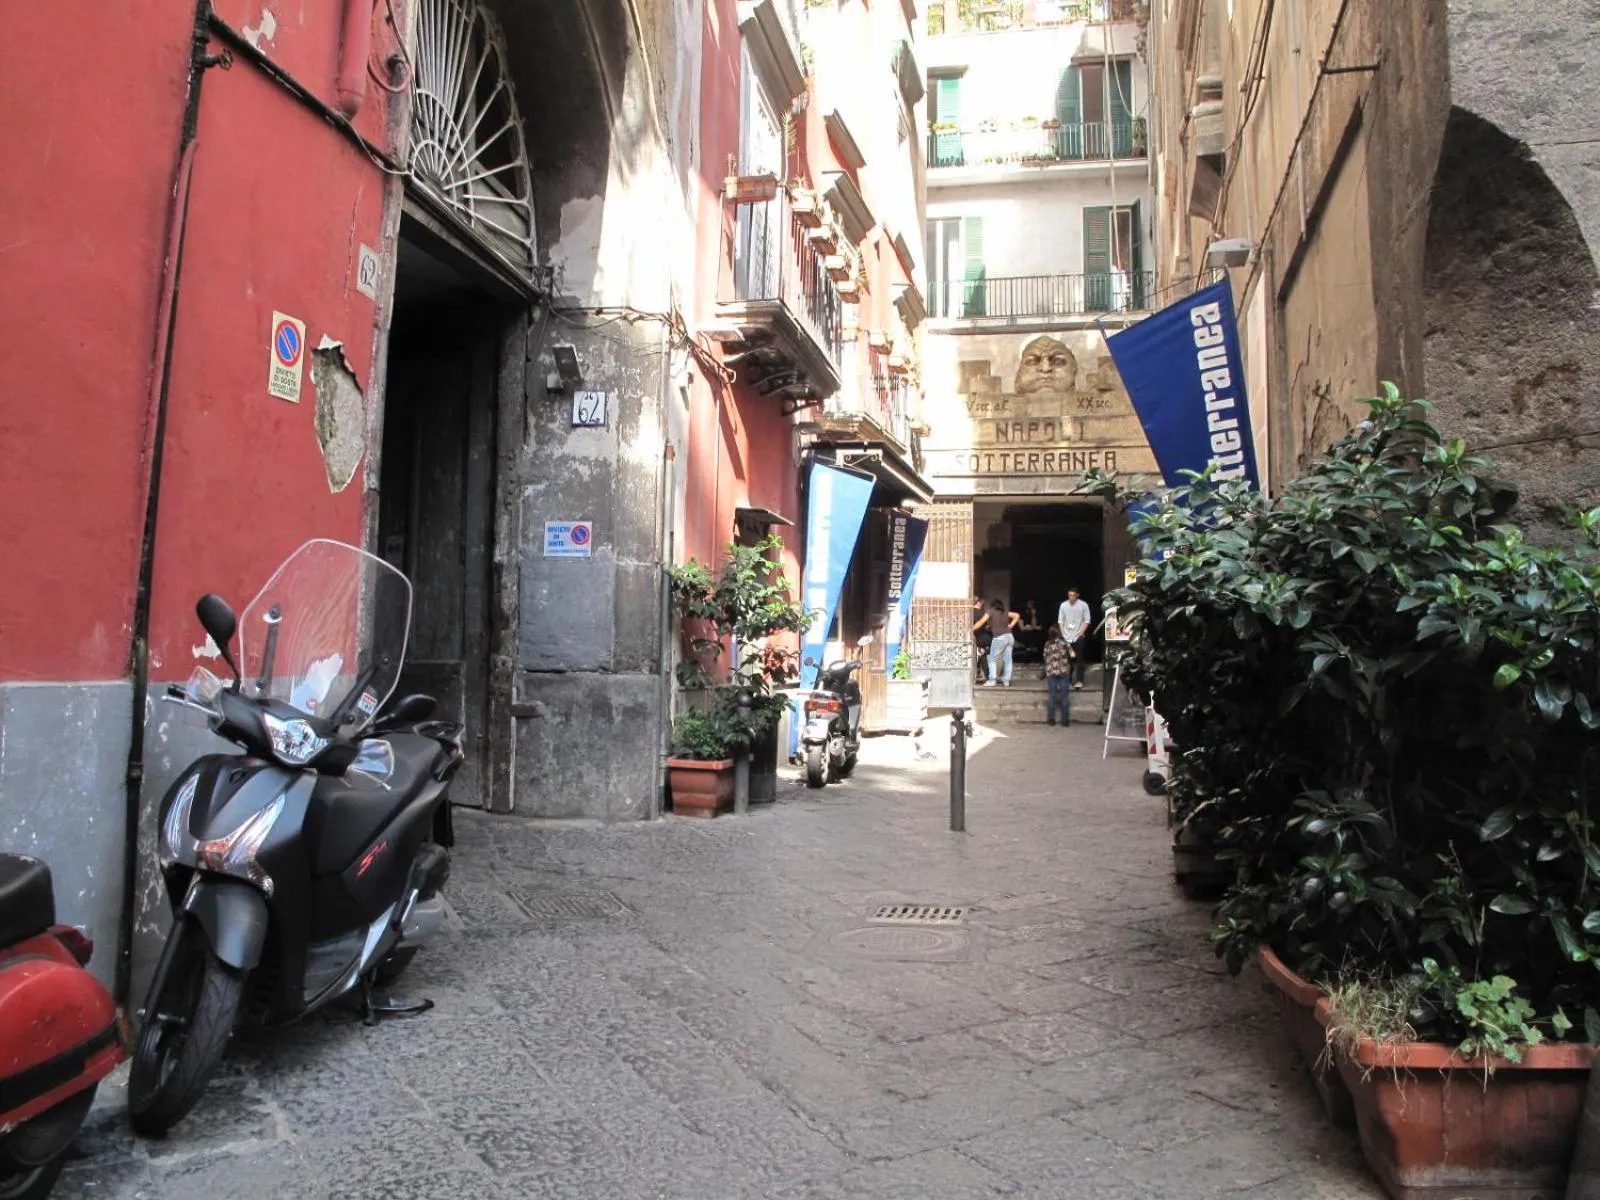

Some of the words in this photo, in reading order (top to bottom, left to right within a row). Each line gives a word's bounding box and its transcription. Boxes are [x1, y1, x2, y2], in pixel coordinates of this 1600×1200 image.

[360, 255, 376, 287] 62
[578, 391, 601, 424] 62
[1190, 302, 1246, 502] tterranea
[995, 421, 1085, 441] NAPOLI
[955, 450, 1118, 473] SOTTERRANEA
[888, 518, 907, 599] Sotterranea
